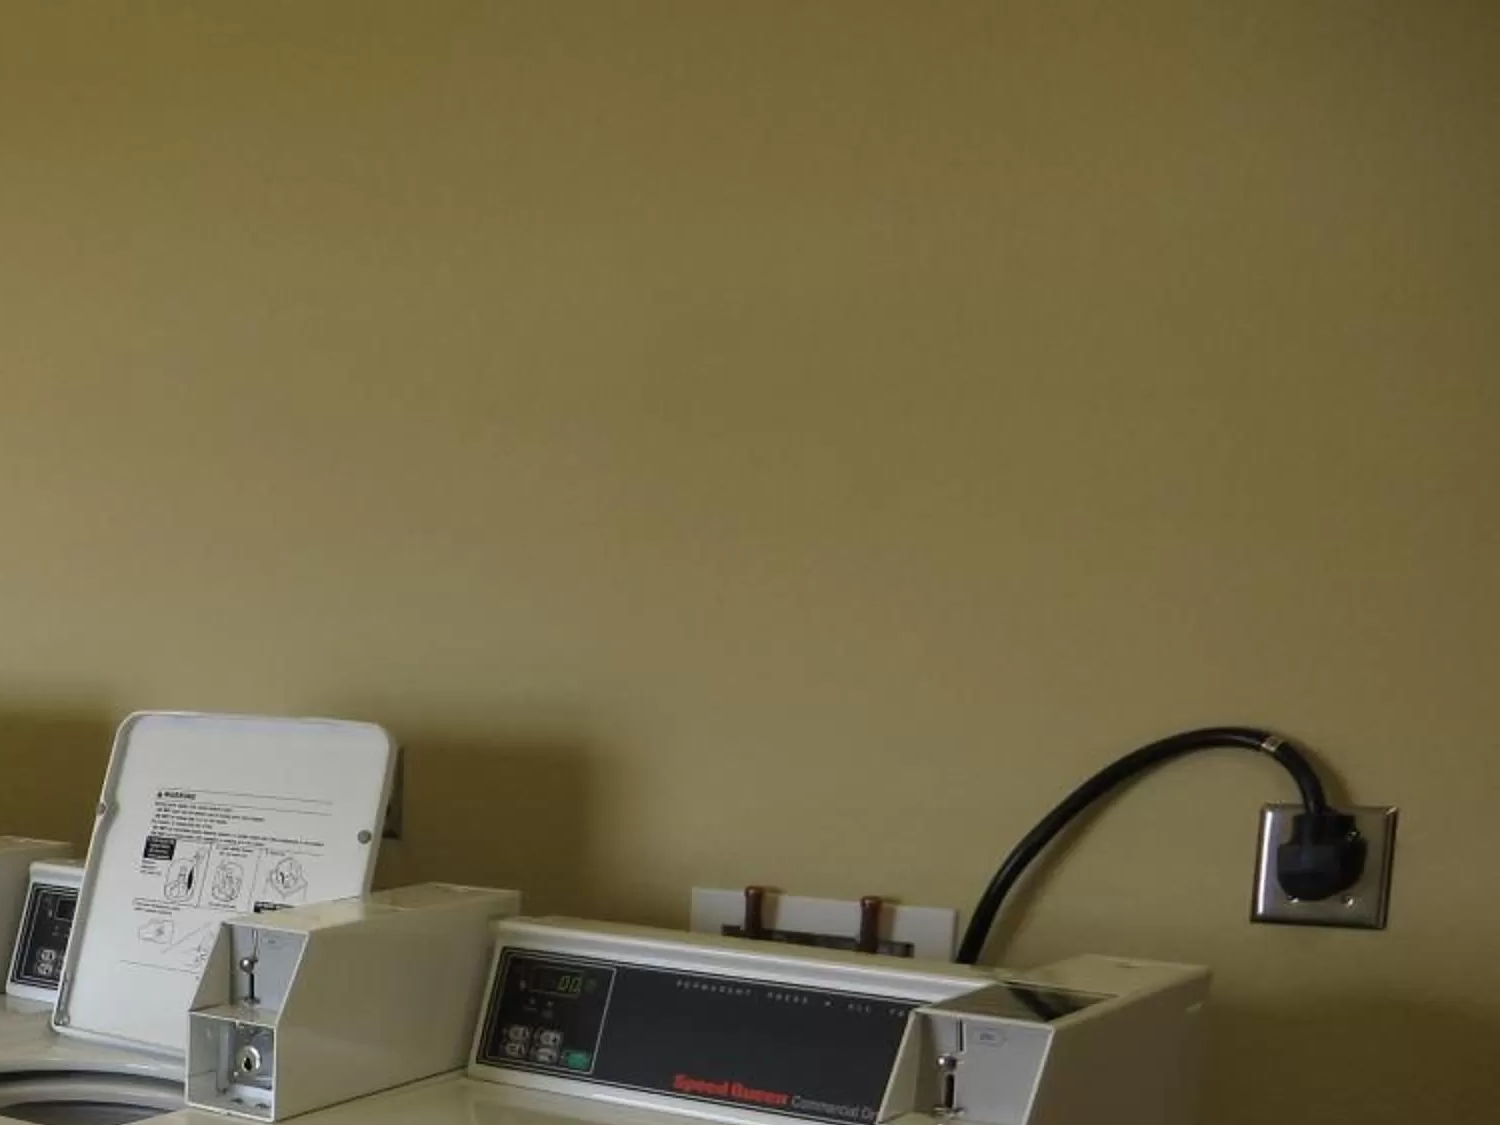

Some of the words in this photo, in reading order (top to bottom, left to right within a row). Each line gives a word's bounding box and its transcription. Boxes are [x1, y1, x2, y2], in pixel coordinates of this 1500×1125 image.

[673, 1073, 729, 1096] Speed
[730, 1081, 789, 1106] Queen
[791, 1095, 859, 1117] Commercial
